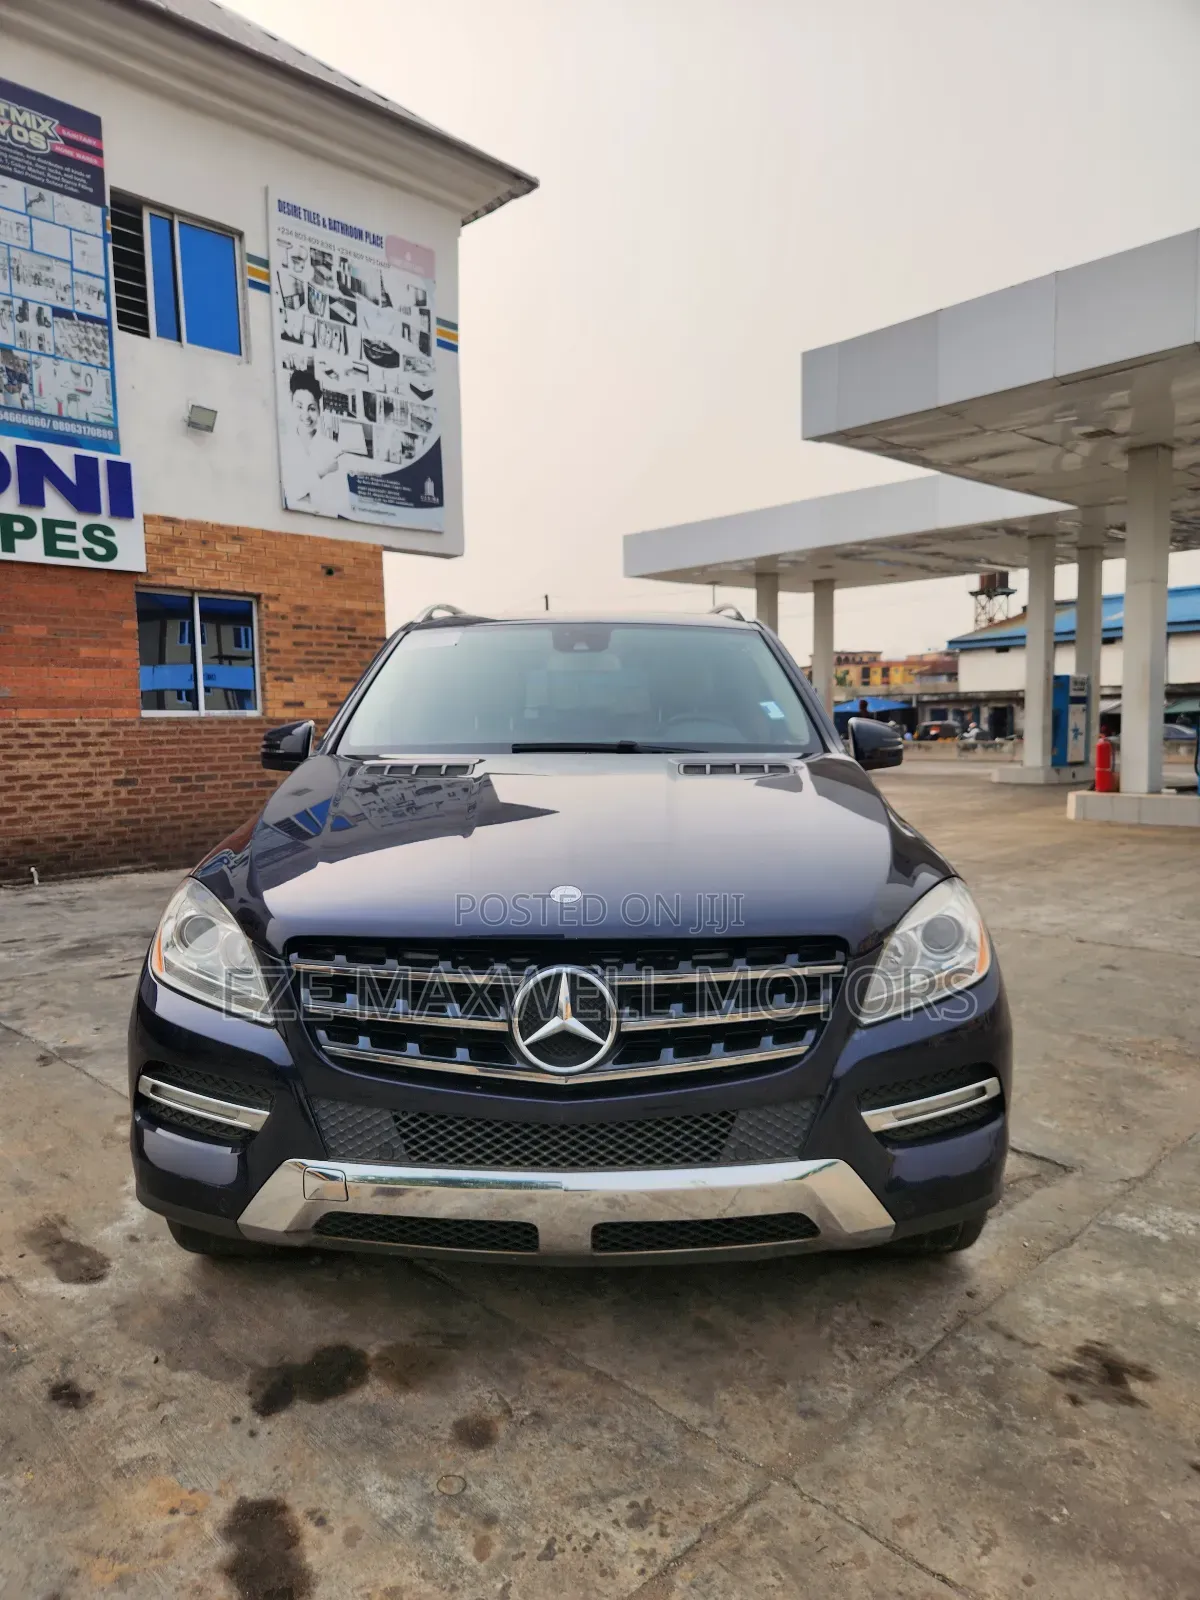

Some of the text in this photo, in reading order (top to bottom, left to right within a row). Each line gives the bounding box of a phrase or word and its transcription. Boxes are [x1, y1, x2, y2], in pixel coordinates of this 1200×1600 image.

[61, 128, 97, 147] SANITARY
[277, 199, 384, 249] DESIRE TILES & BATHROOM PLACE
[0, 444, 135, 519] NI
[0, 512, 118, 562] PES
